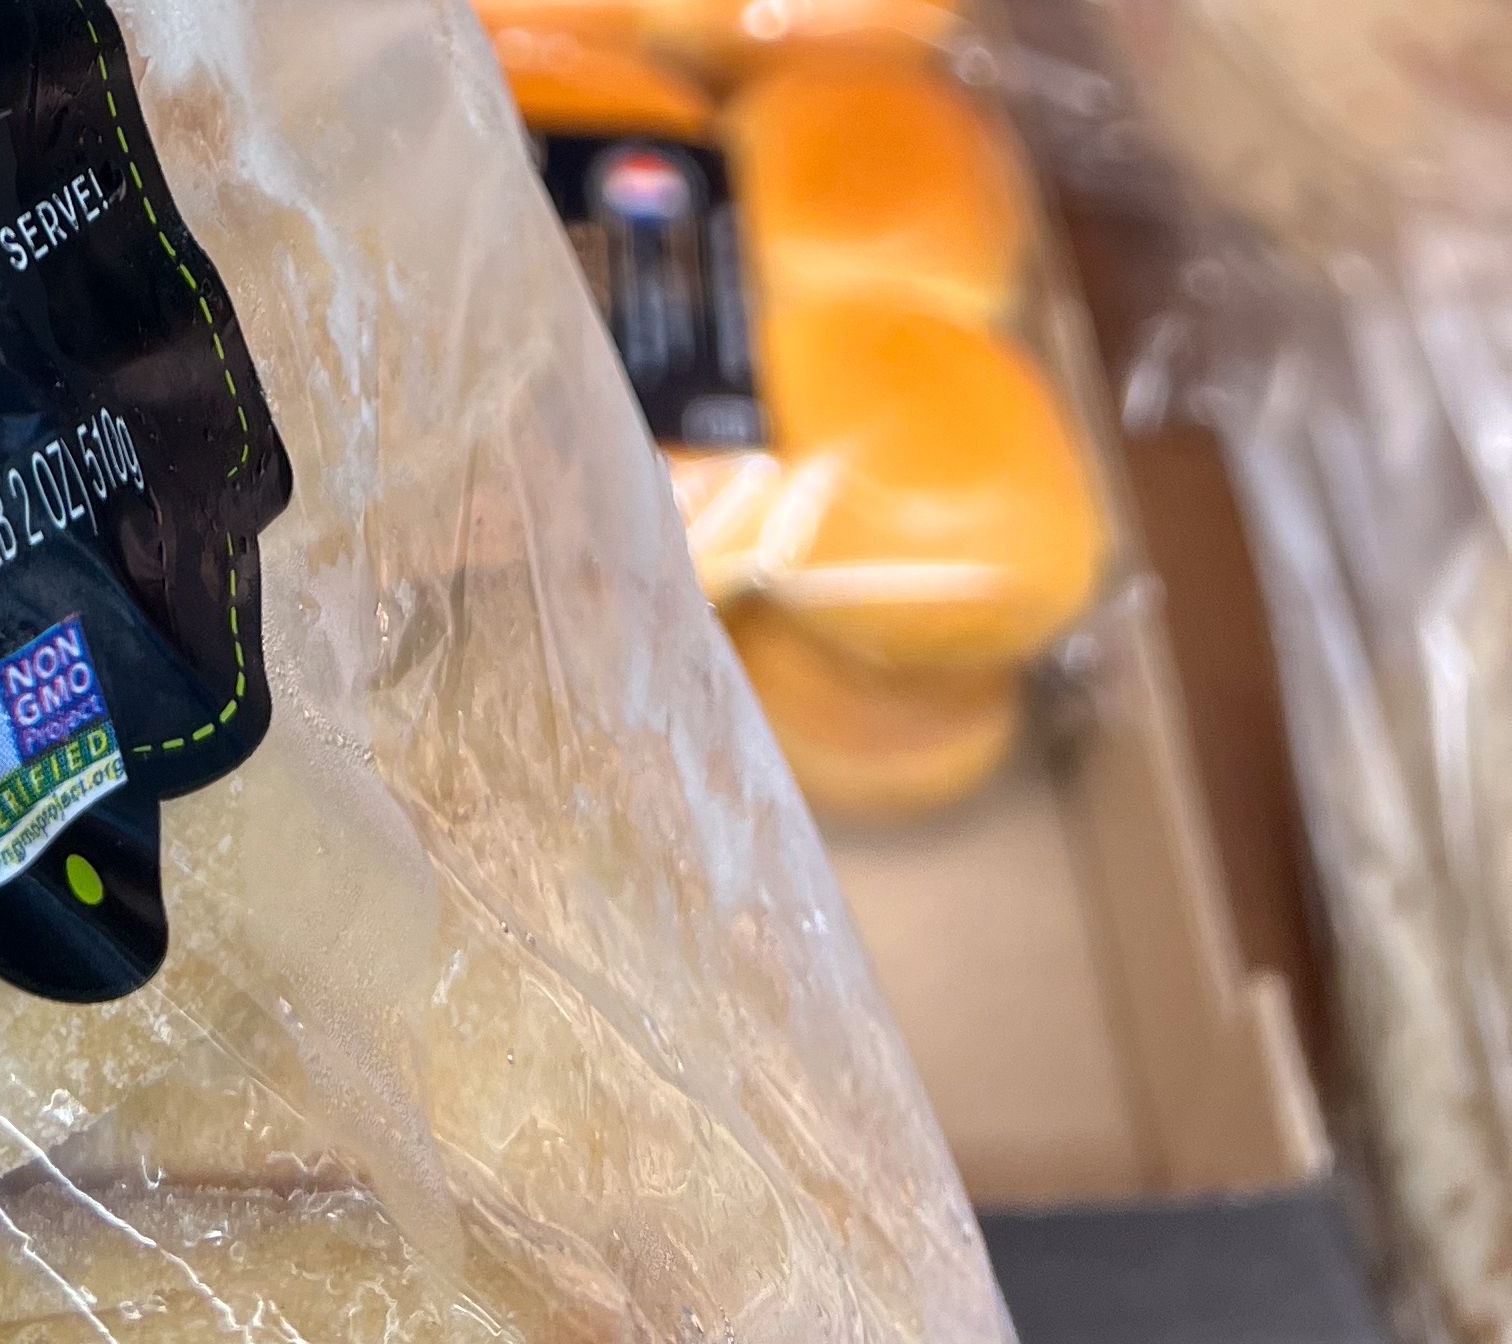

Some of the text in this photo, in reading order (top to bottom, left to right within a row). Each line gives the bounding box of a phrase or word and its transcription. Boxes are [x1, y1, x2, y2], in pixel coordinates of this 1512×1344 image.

[8, 467, 44, 547] 2
[32, 436, 99, 537] OZ)
[75, 406, 146, 501] 510g
[3, 627, 84, 696] NON
[12, 660, 91, 728] GMO
